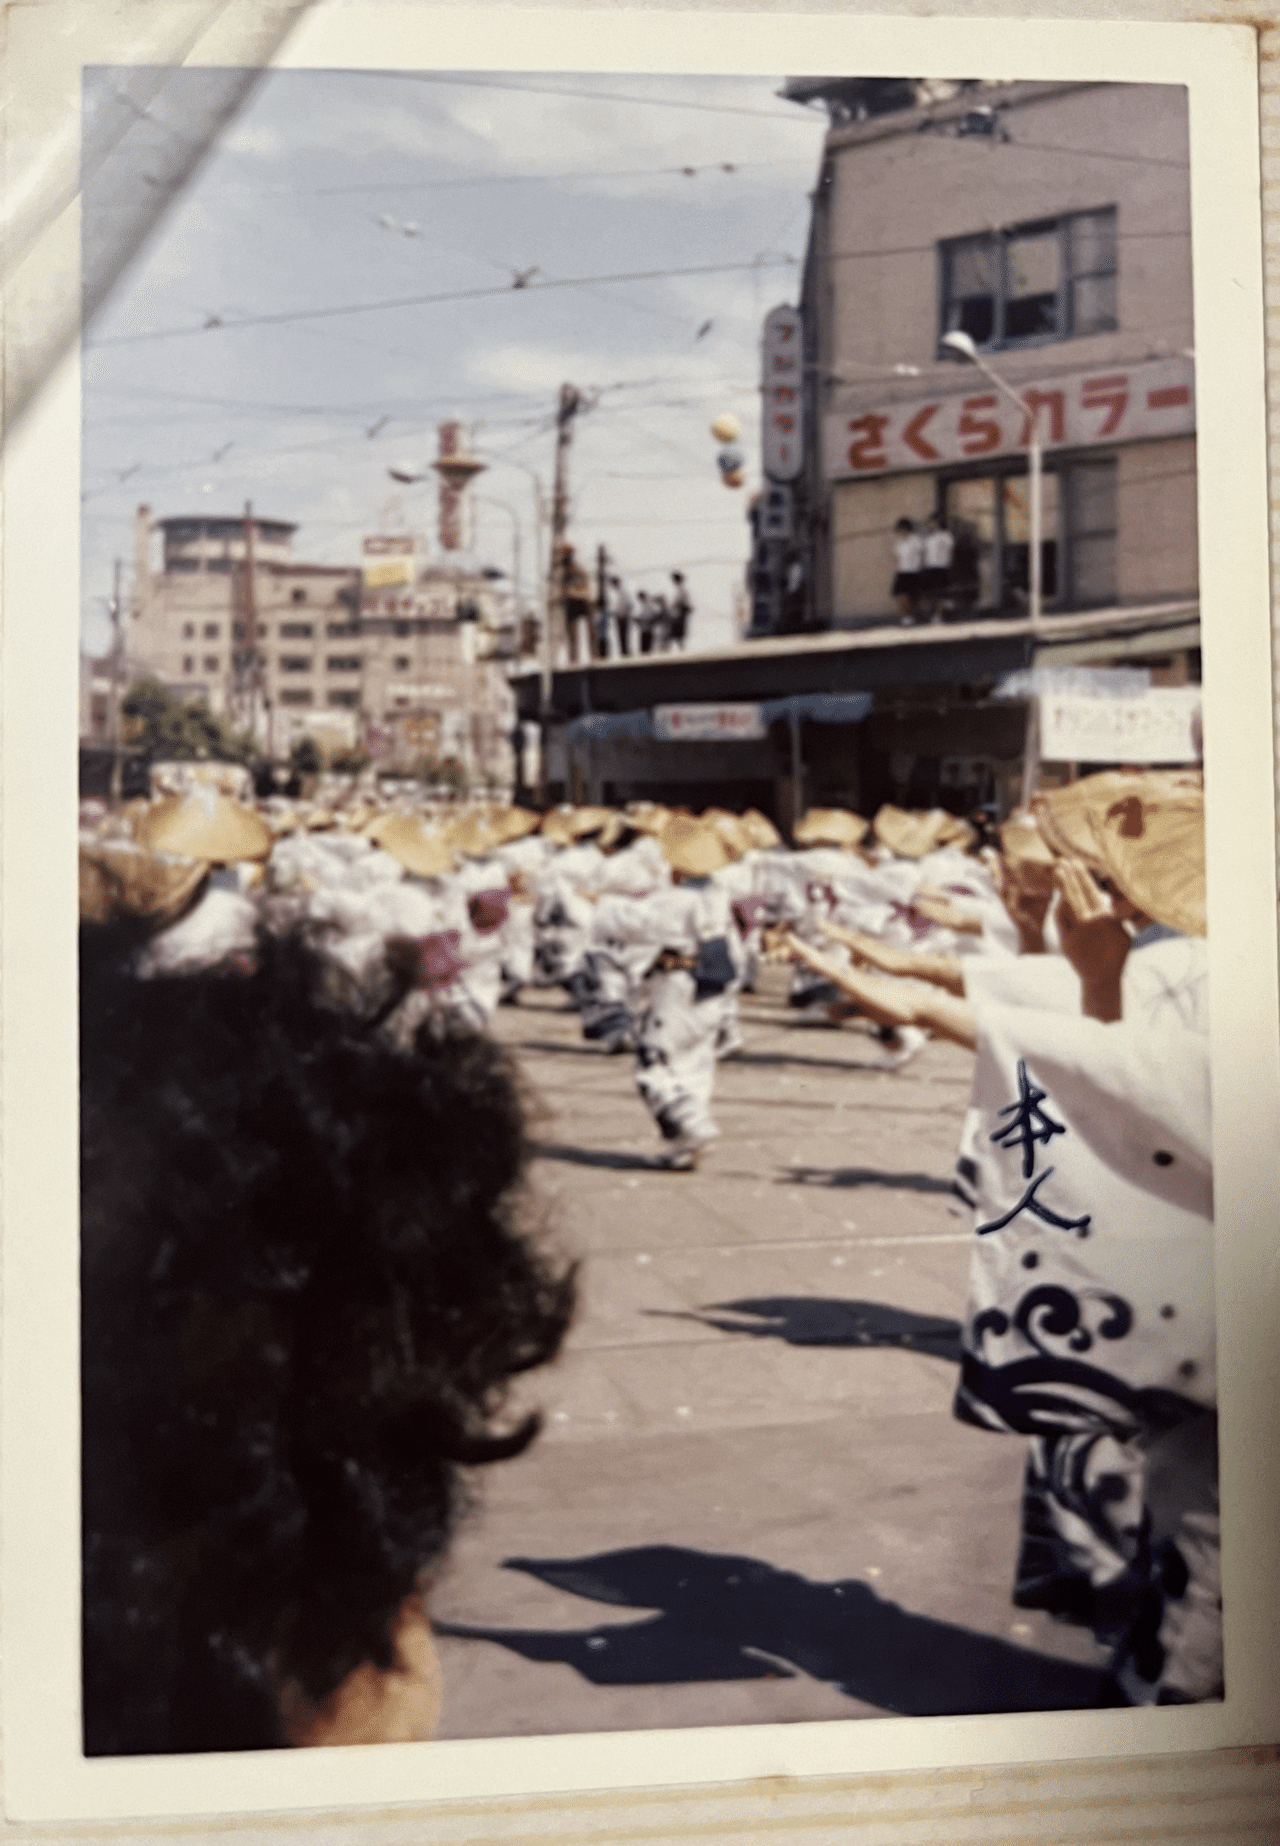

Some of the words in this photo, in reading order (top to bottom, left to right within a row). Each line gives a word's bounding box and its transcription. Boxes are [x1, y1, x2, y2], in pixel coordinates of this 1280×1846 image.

[847, 376, 1191, 470] さくらカラー
[975, 1058, 1091, 1236] 本人
